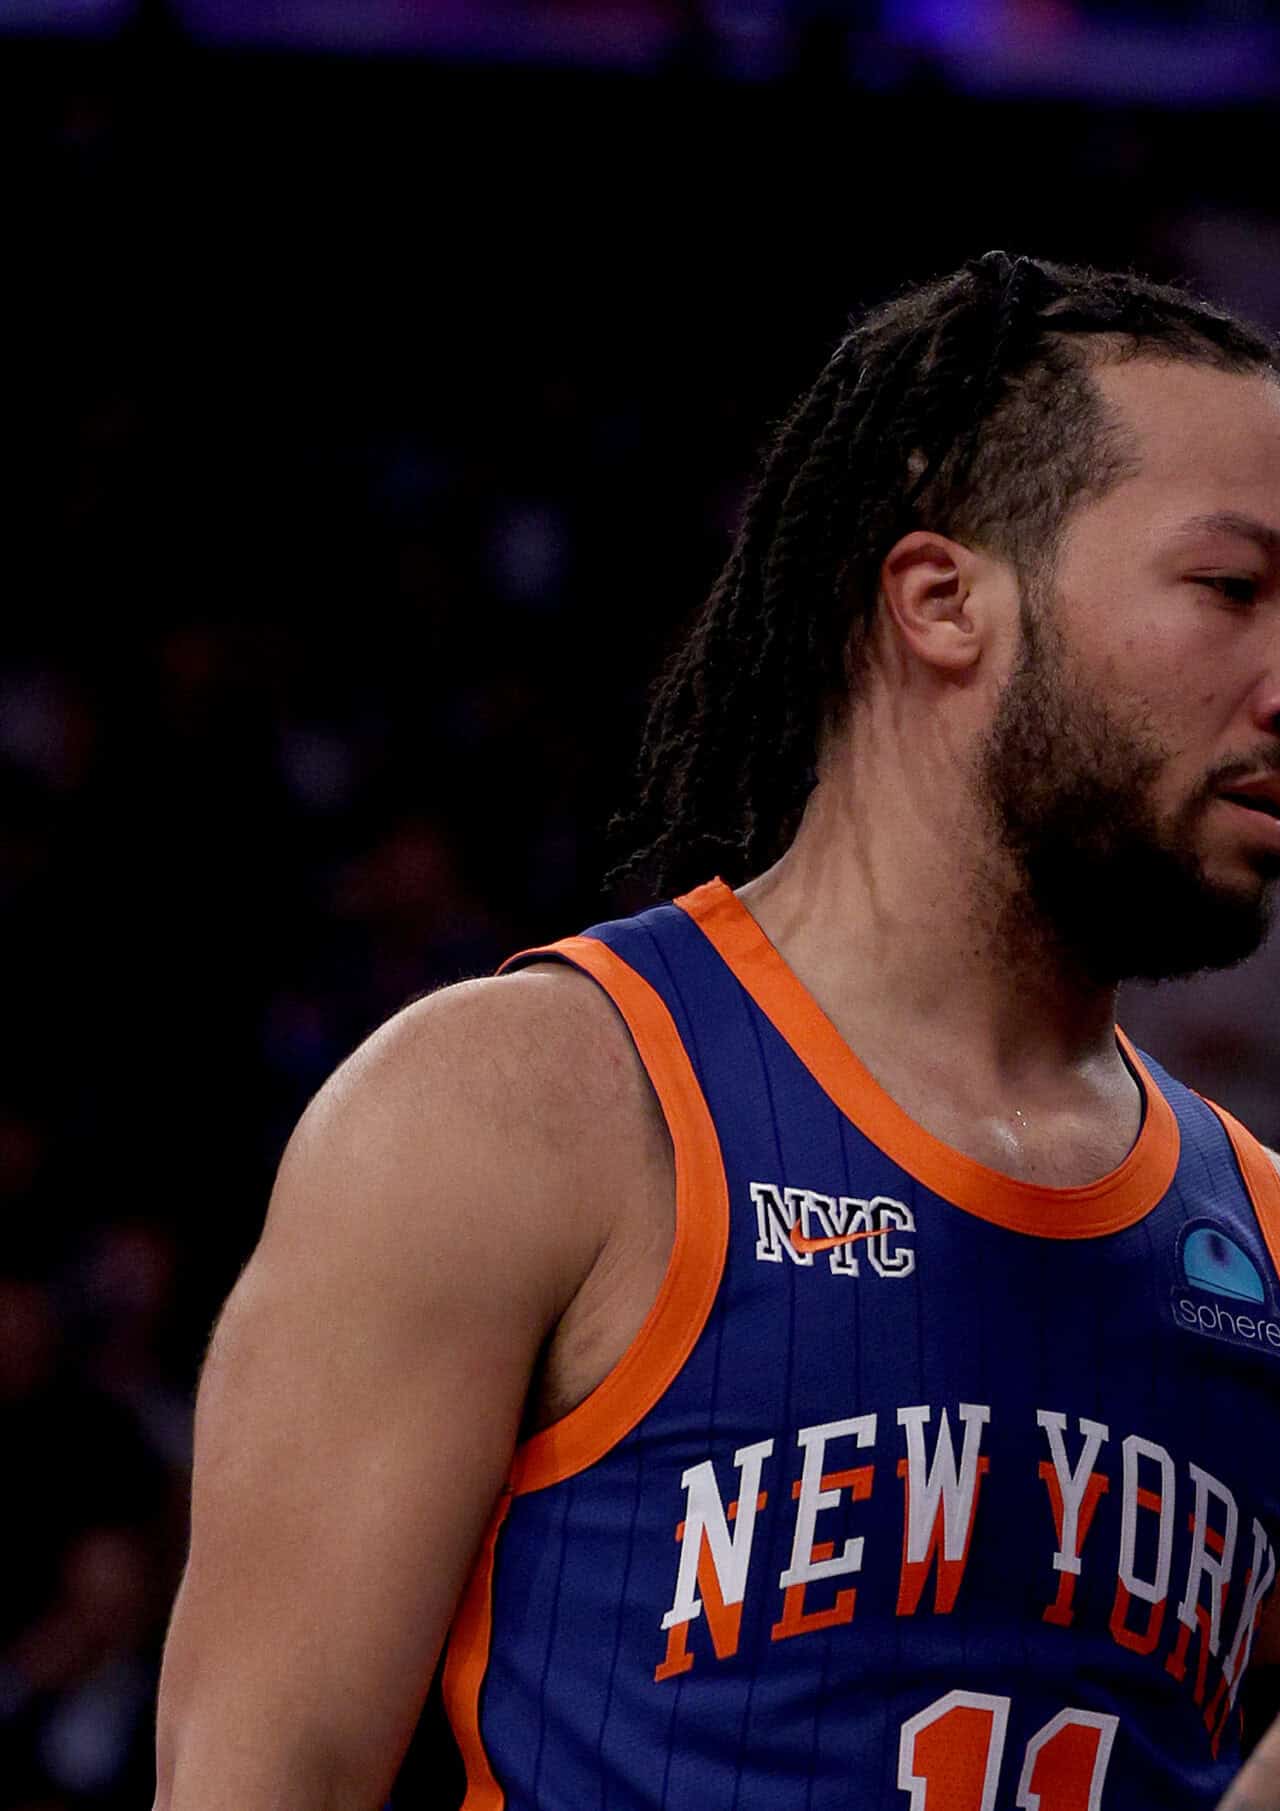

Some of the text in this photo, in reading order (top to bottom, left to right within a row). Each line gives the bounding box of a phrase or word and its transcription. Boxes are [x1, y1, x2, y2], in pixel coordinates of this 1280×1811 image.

[750, 1183, 916, 1277] NYC
[655, 1403, 1275, 1760] NEW YORK
